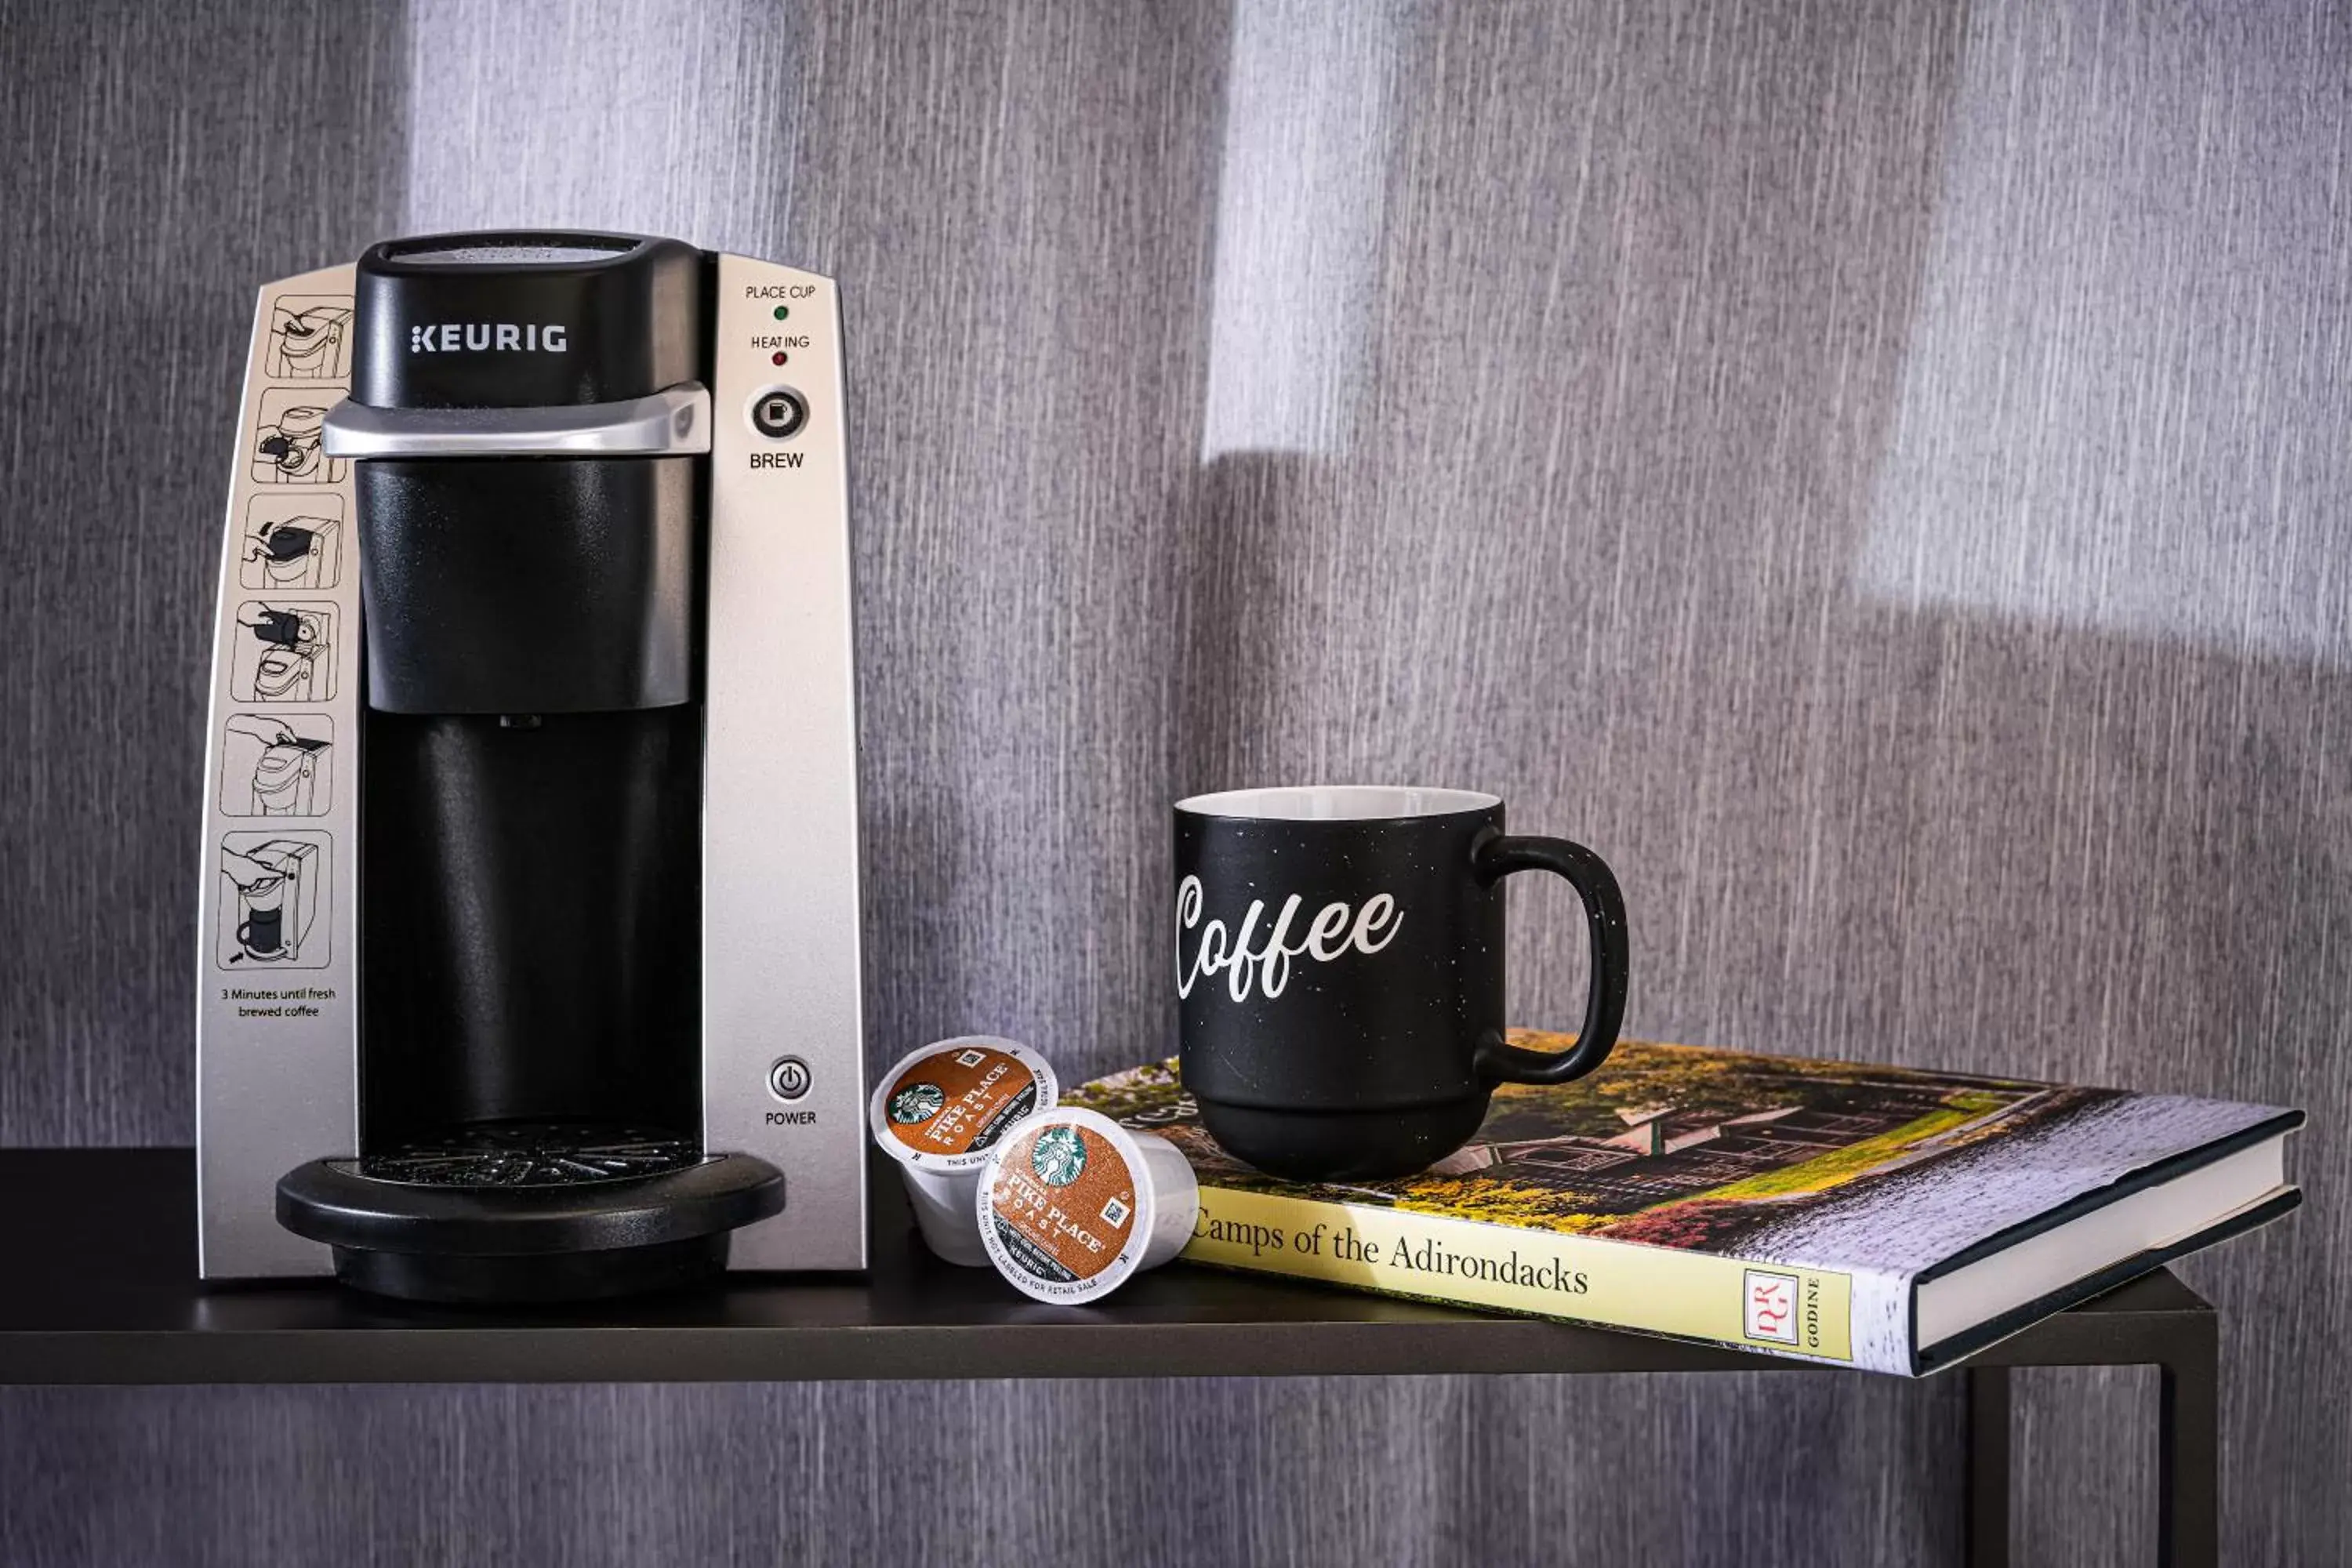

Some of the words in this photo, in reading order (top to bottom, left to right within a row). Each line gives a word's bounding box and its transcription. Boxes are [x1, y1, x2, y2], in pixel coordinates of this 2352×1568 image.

[746, 285, 786, 299] PLACE
[789, 285, 816, 299] CUP
[411, 323, 568, 354] KEURIG
[751, 336, 811, 349] HEATING
[750, 453, 804, 469] BREW
[1177, 874, 1404, 1003] Coffee
[221, 989, 228, 1000] 3
[231, 989, 278, 1000] Minutes
[280, 988, 307, 1000] until
[308, 987, 336, 1000] fresh
[238, 1006, 281, 1017] brewed
[285, 1004, 320, 1017] coffee
[929, 1105, 967, 1142] PIKE
[963, 1062, 1008, 1105] PLACE
[766, 1111, 816, 1126] POWER
[1008, 1175, 1047, 1210] PIKE
[1048, 1205, 1102, 1253] PLACE
[1191, 1206, 1284, 1258] Camps
[1294, 1223, 1327, 1255] of
[1334, 1227, 1380, 1263] the
[1388, 1236, 1588, 1295] Adirondacks
[1029, 1280, 1046, 1293] FOR
[1077, 1279, 1098, 1293] SALE
[1808, 1278, 1820, 1348] GODINE
